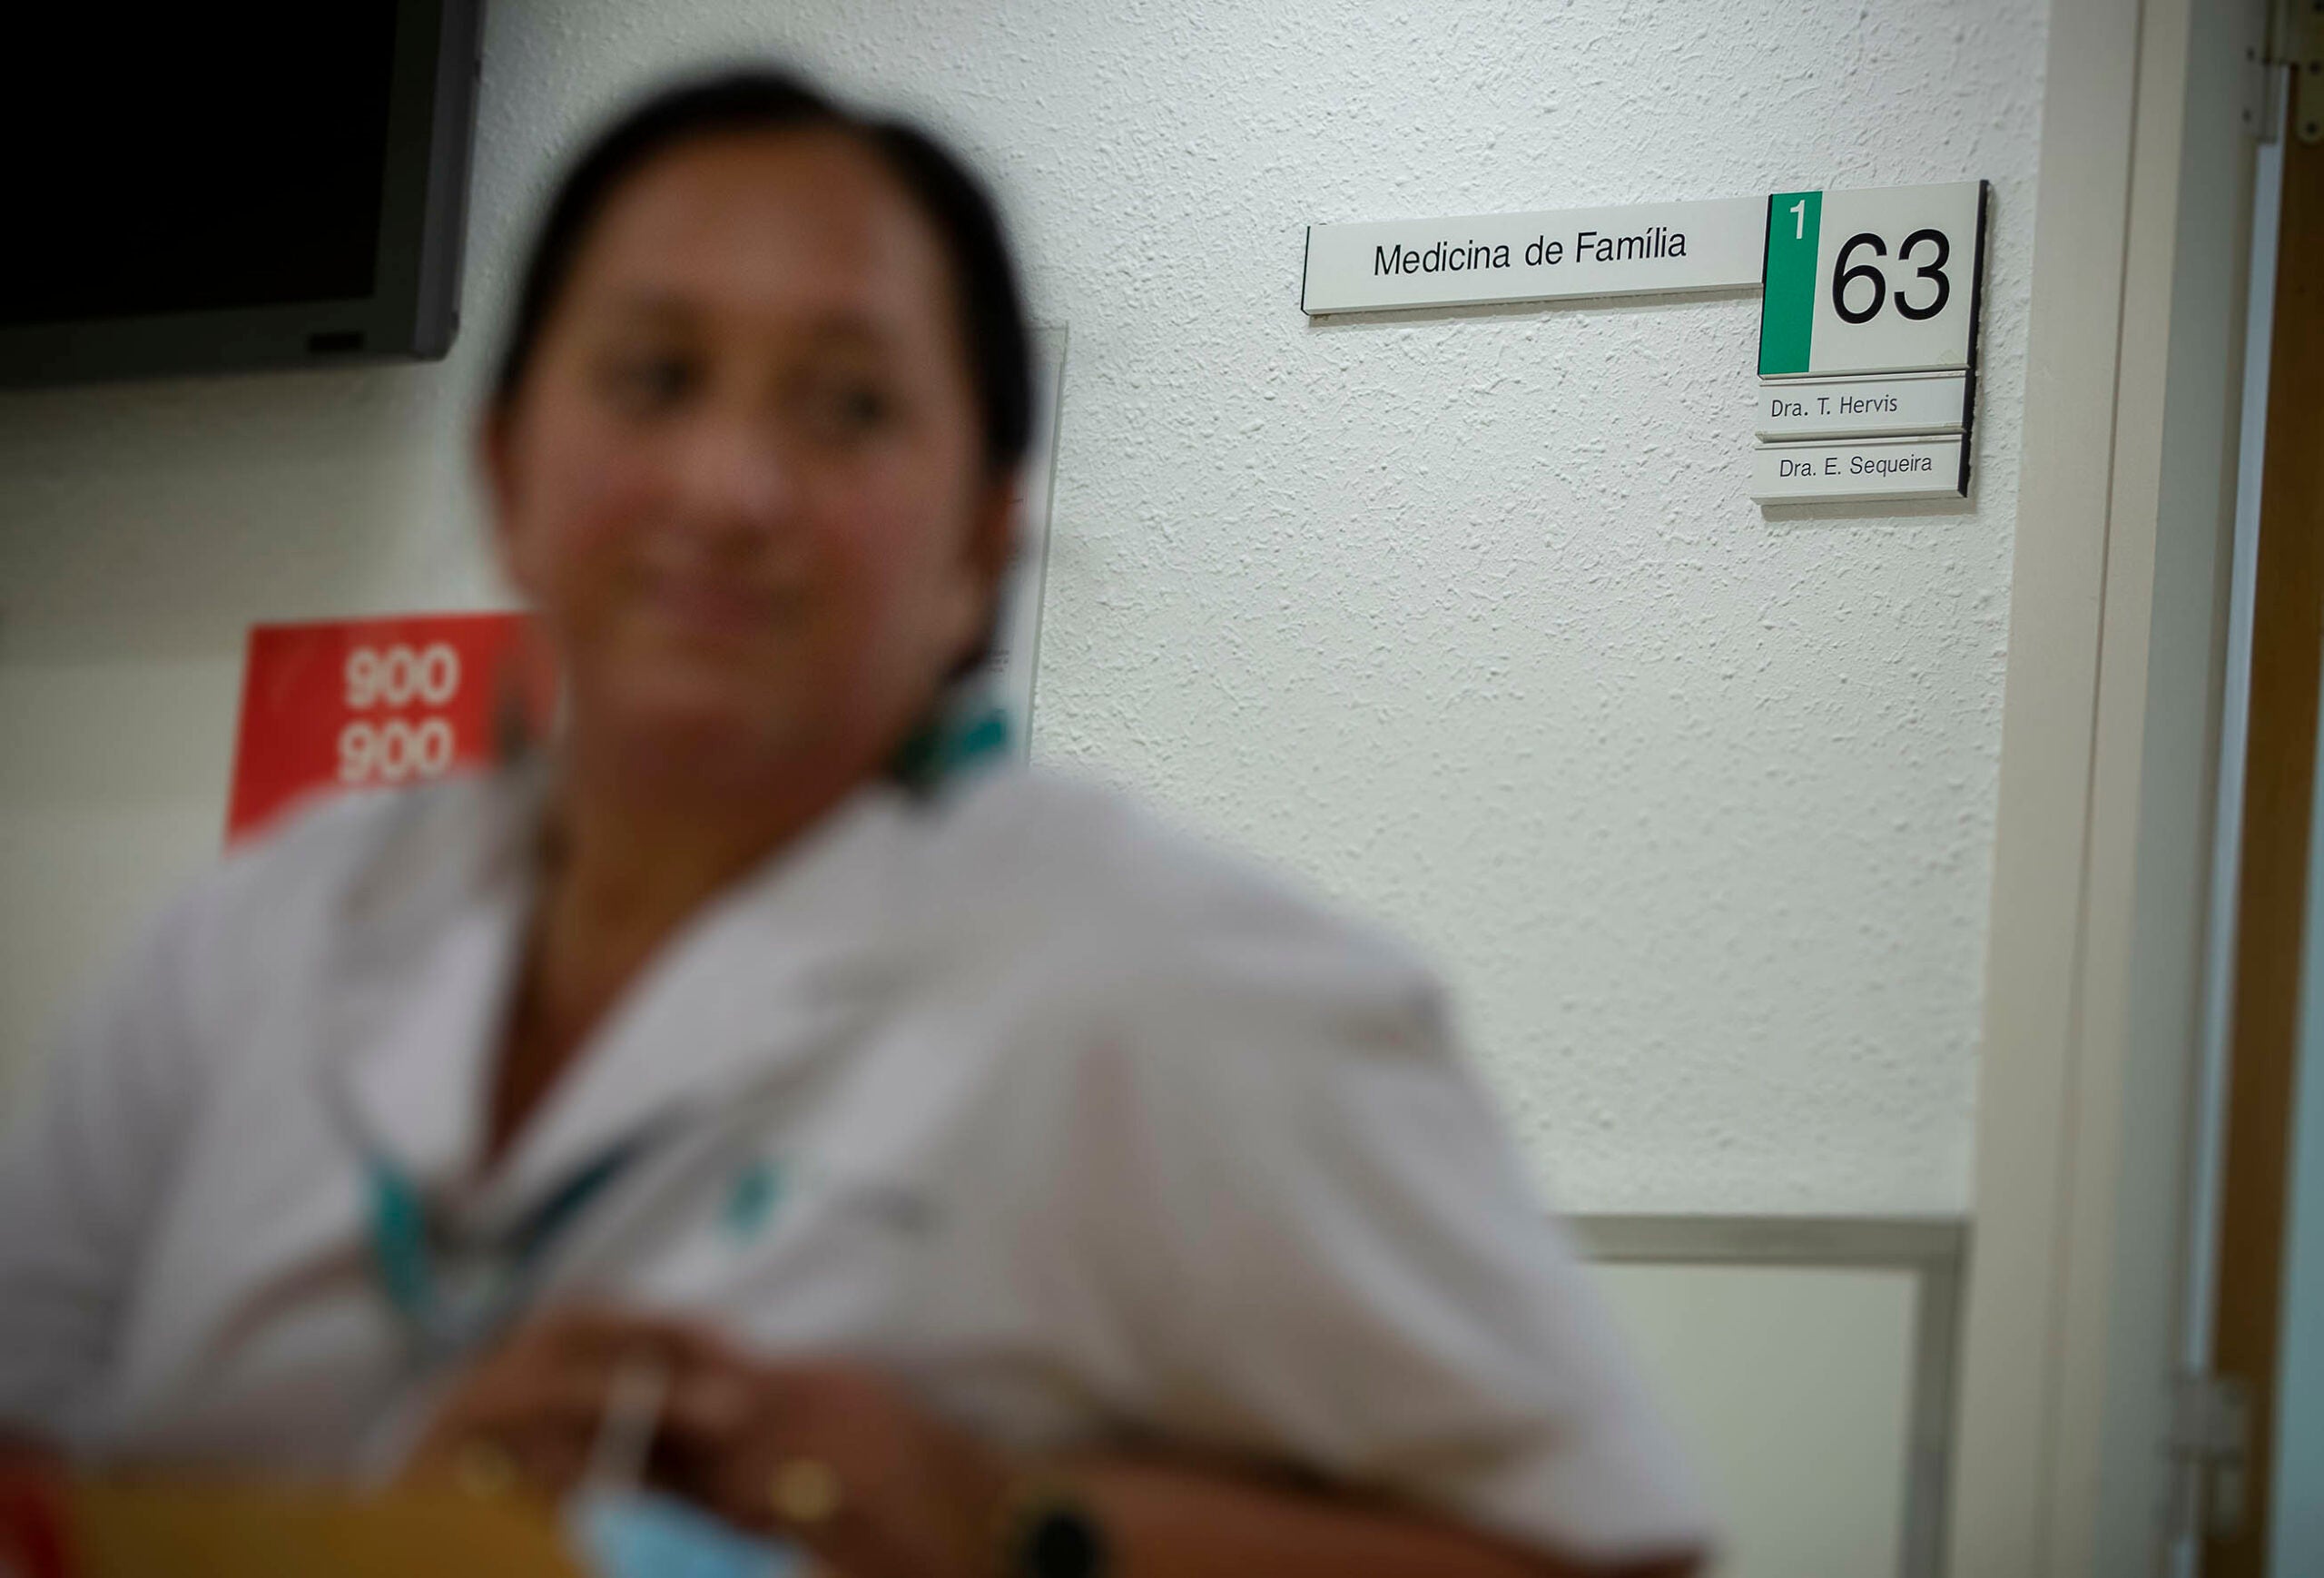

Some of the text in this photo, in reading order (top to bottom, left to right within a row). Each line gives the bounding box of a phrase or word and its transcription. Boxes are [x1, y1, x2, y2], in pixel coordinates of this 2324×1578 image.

[1789, 199, 1805, 240] 1
[1374, 226, 1687, 276] Medicina de Família
[1832, 228, 1950, 324] 63
[1770, 393, 1898, 419] Dra. T. Hervis
[1779, 453, 1933, 478] Dra. E. Sequeira
[344, 643, 460, 709] 900
[339, 718, 455, 783] 900
